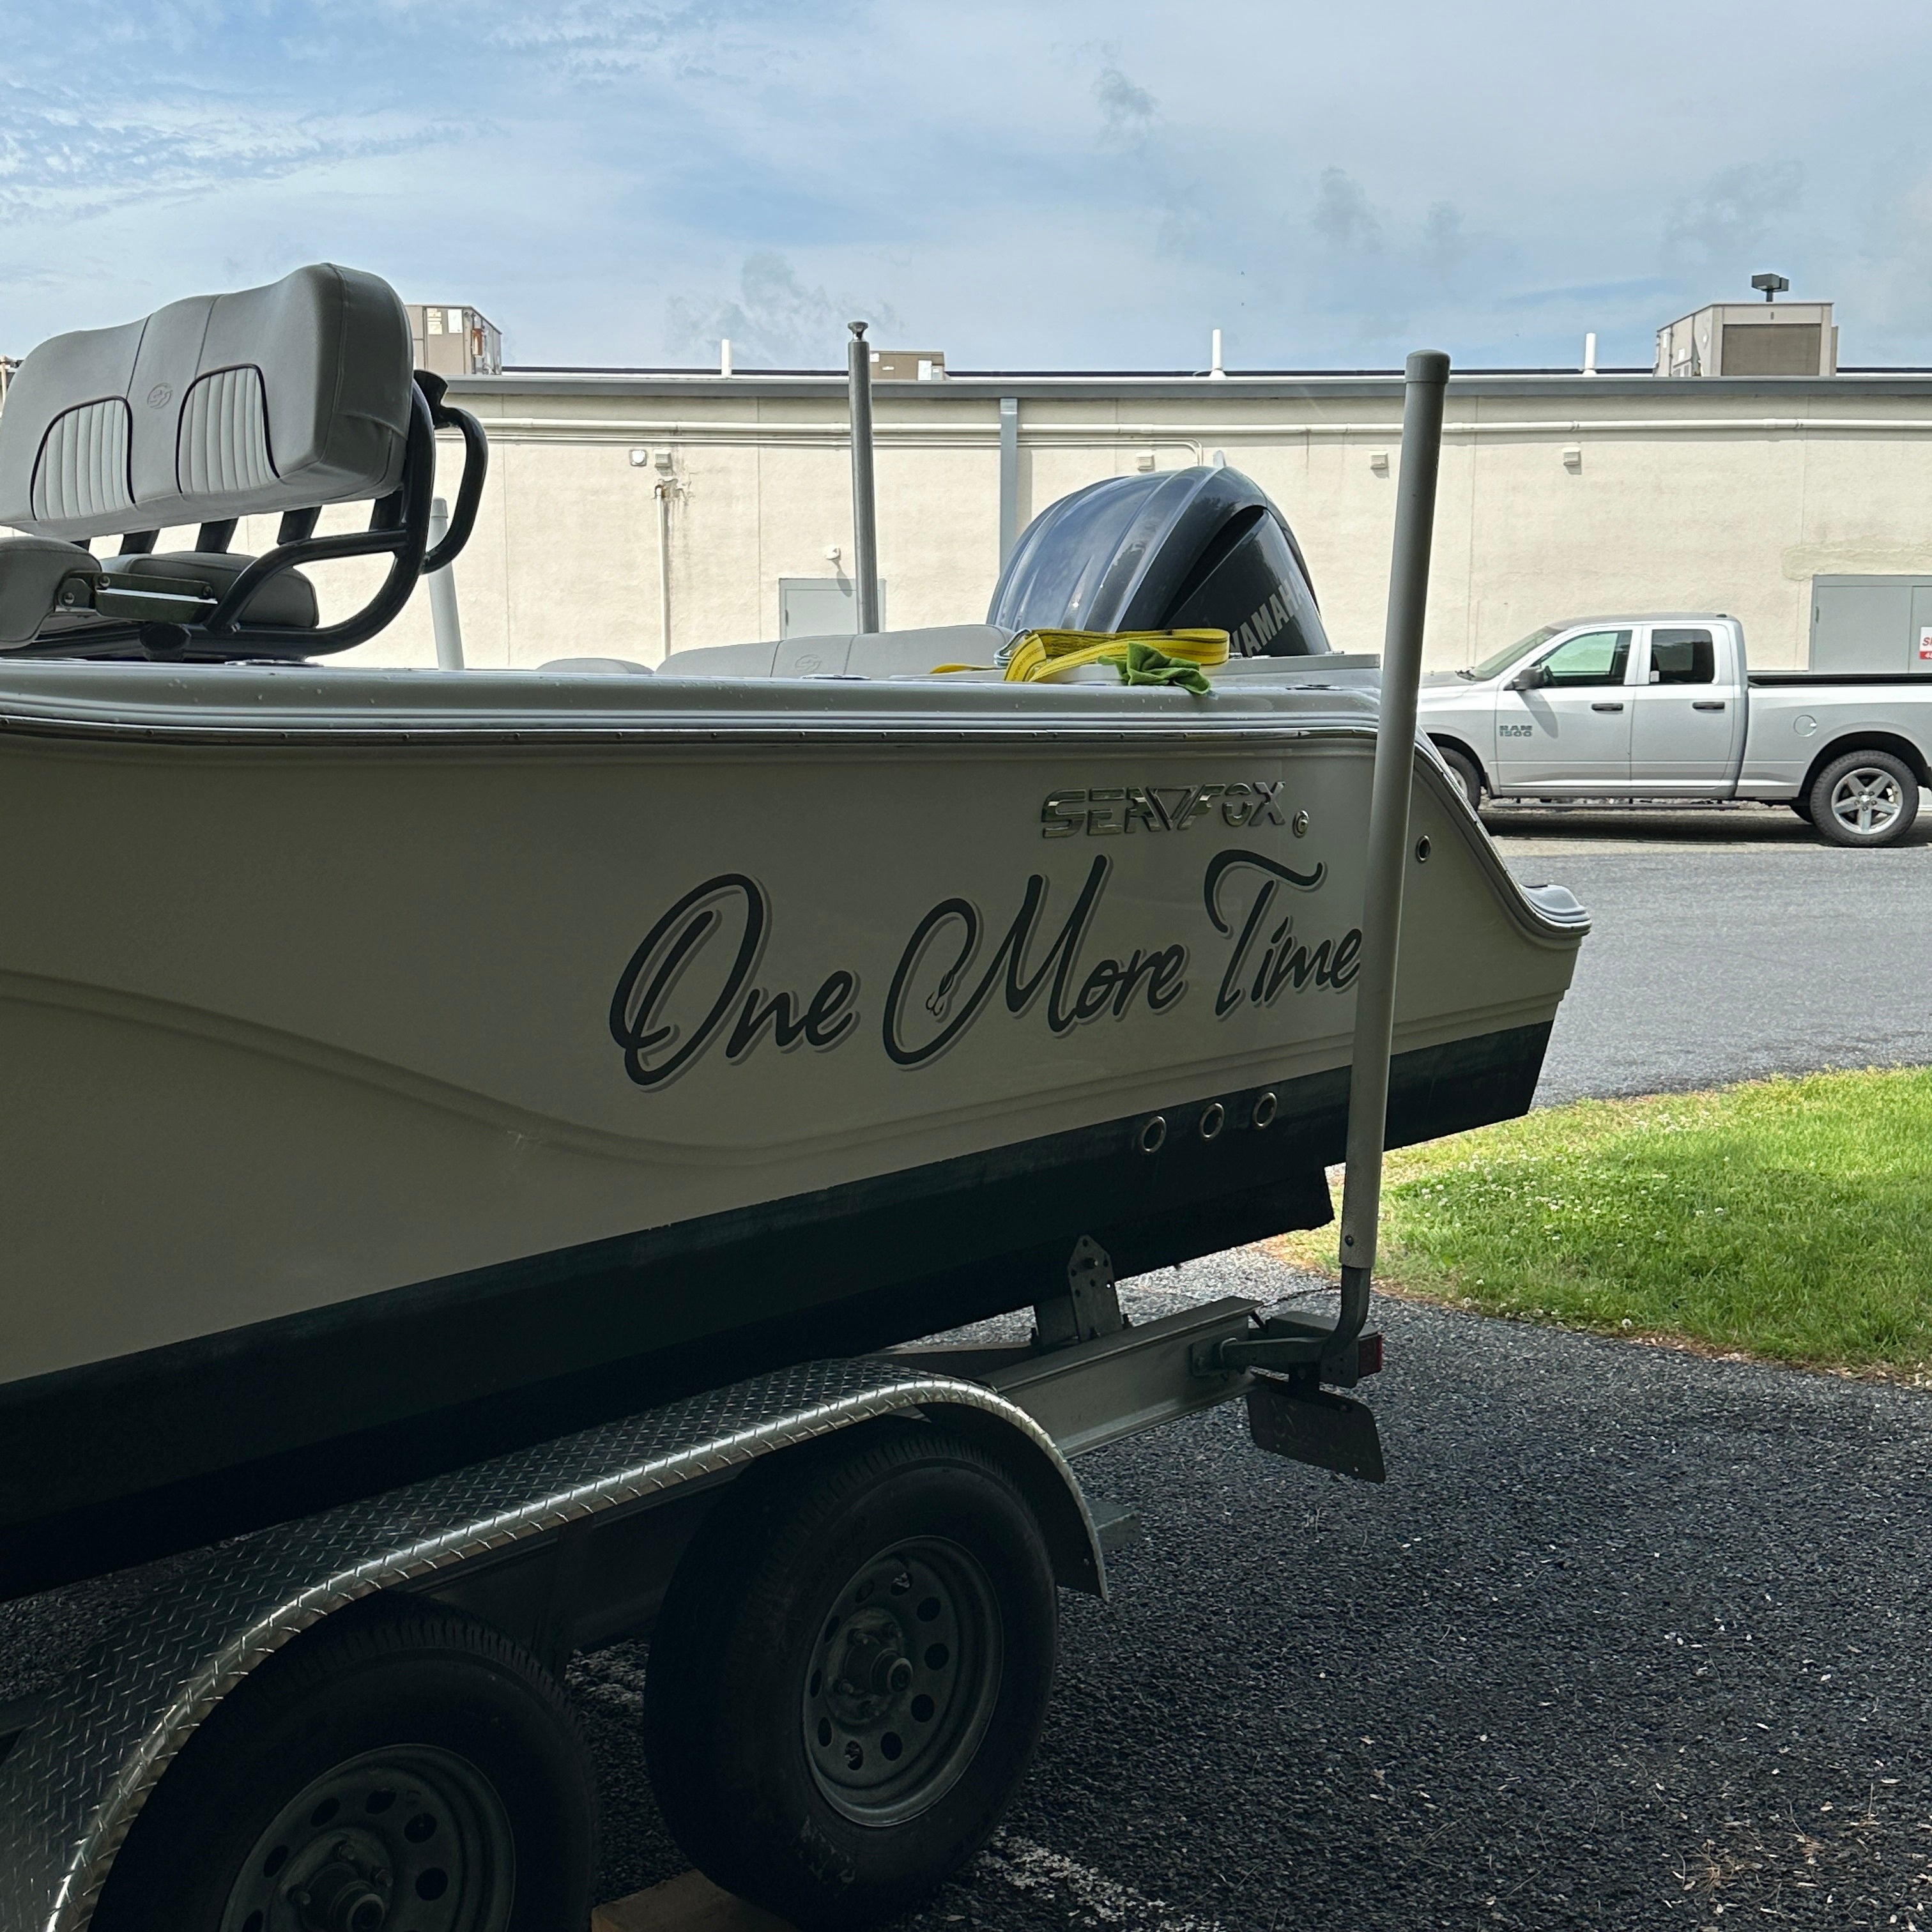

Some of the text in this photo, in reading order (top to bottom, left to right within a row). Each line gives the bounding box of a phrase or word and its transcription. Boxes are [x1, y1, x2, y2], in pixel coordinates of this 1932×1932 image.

[610, 849, 1362, 1094] One More Time
